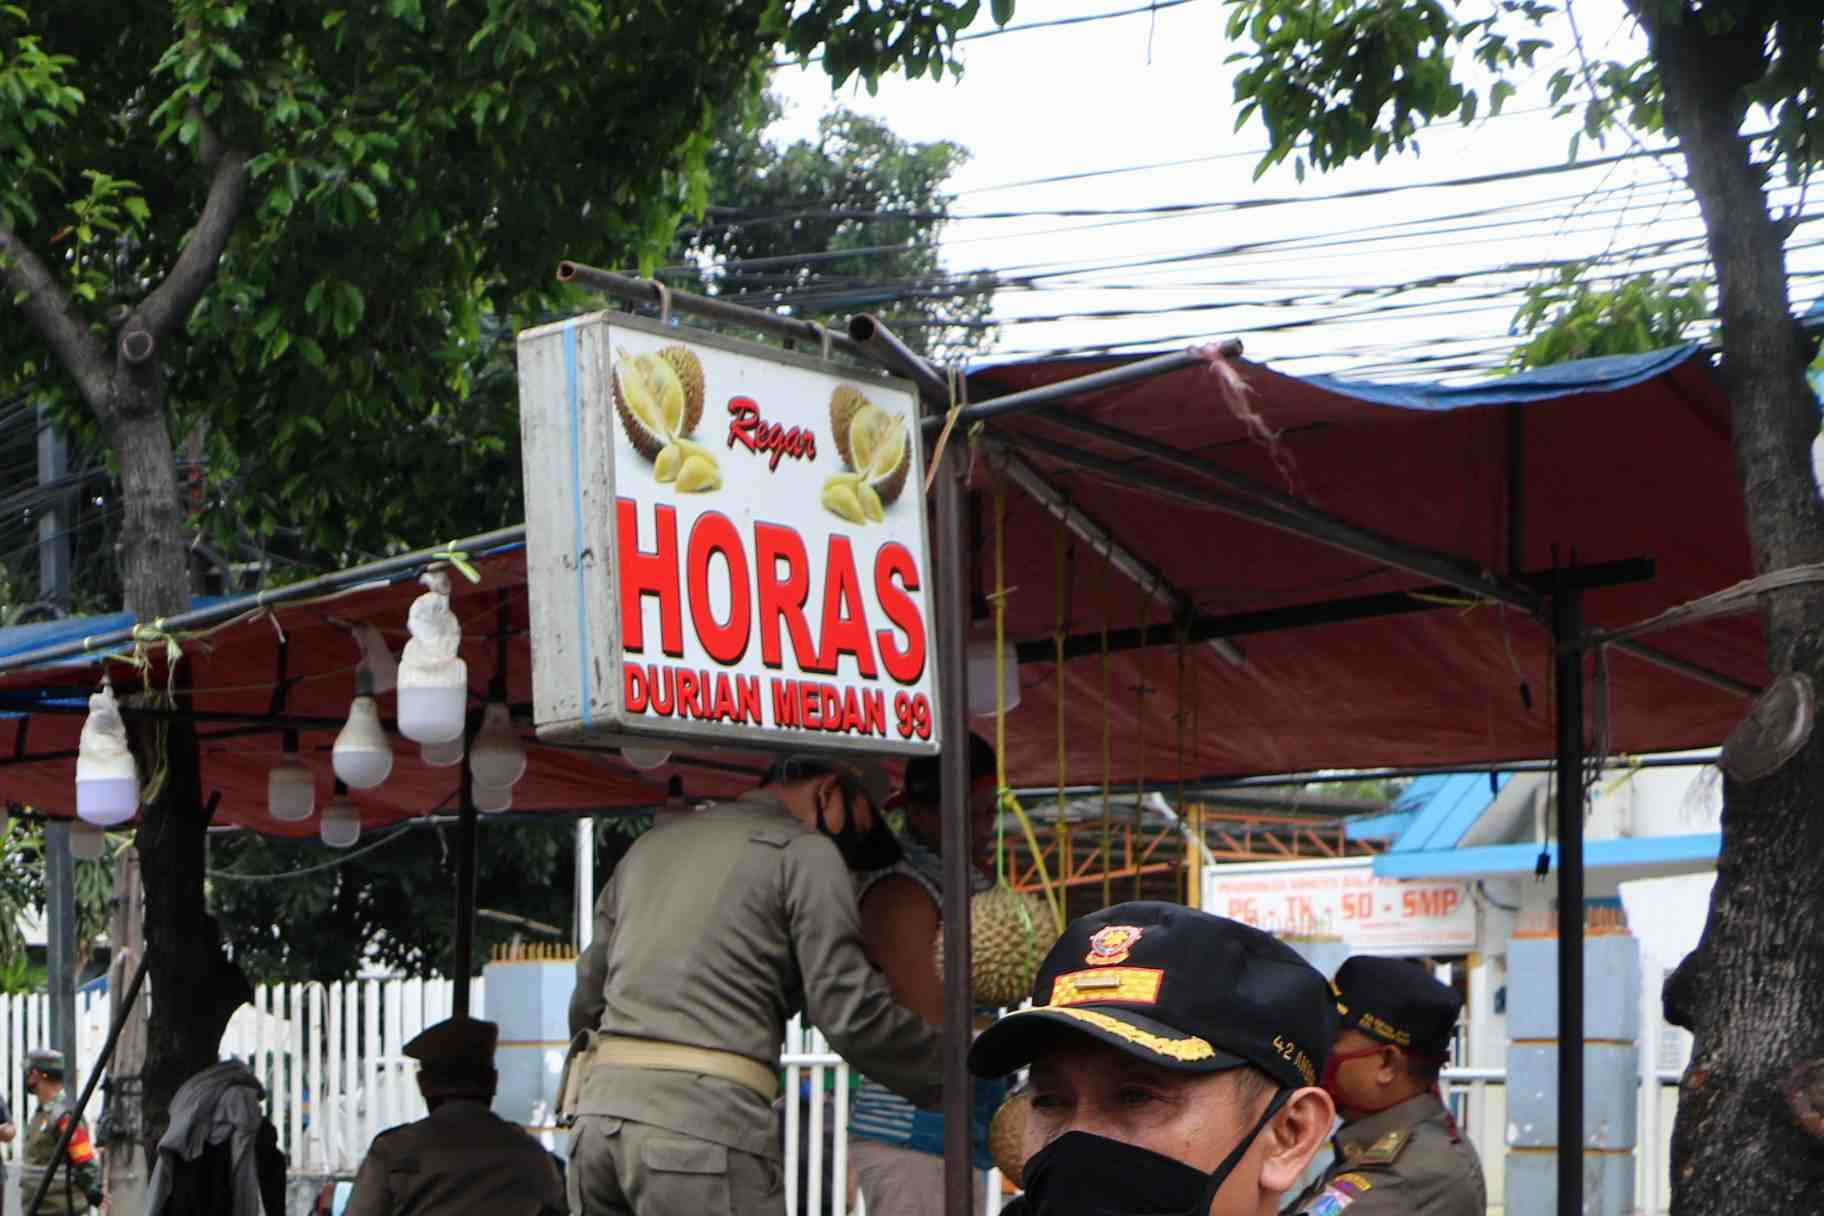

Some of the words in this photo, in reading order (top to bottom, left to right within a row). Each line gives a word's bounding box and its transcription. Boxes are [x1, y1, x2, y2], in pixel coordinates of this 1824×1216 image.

[727, 395, 816, 473] Regar
[616, 496, 926, 685] HORAS
[623, 661, 762, 724] DURIAN
[771, 677, 886, 737] MEDAN
[895, 690, 932, 741] 99
[1341, 892, 1373, 919] SD
[1403, 888, 1458, 918] SMP
